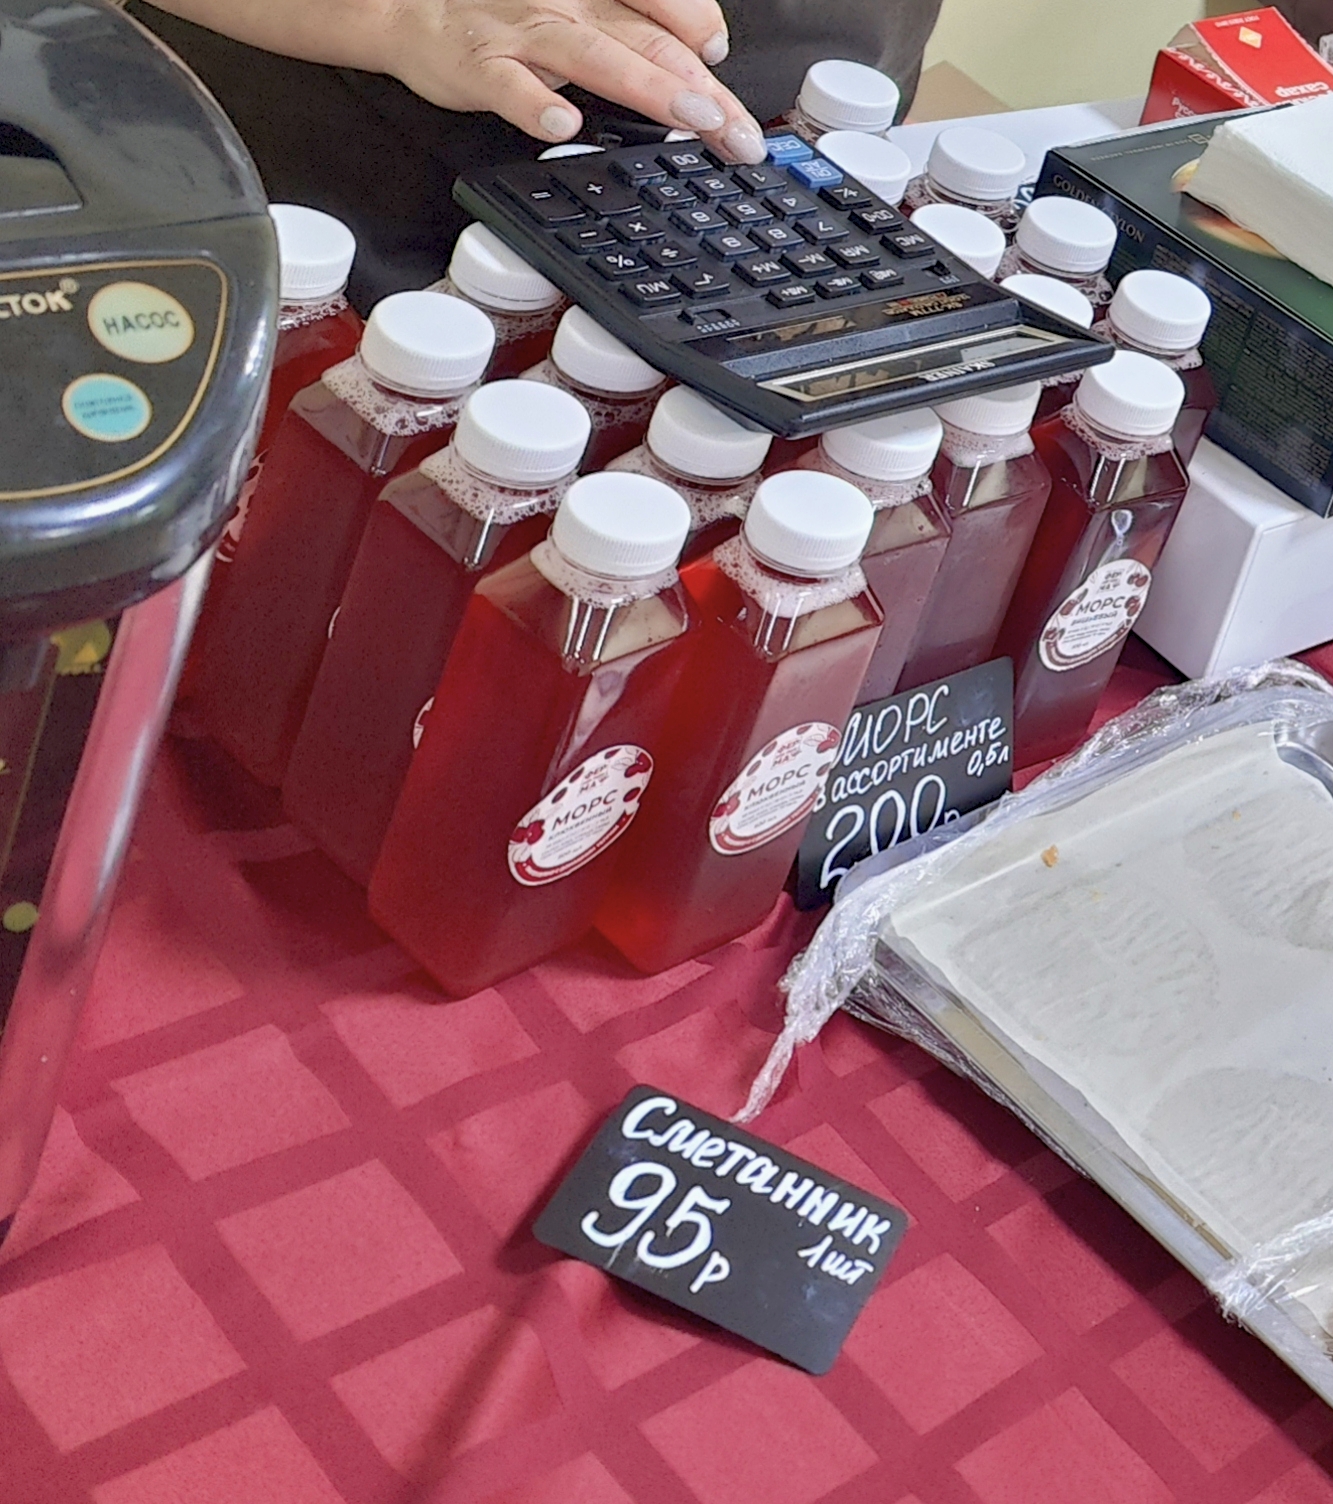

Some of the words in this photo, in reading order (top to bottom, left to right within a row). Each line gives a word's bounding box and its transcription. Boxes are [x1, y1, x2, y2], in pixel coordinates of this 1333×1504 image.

[103, 310, 181, 336] НАСОС
[1075, 596, 1126, 617] МОРС
[746, 763, 812, 803] МОРС
[551, 789, 619, 832] МОРС
